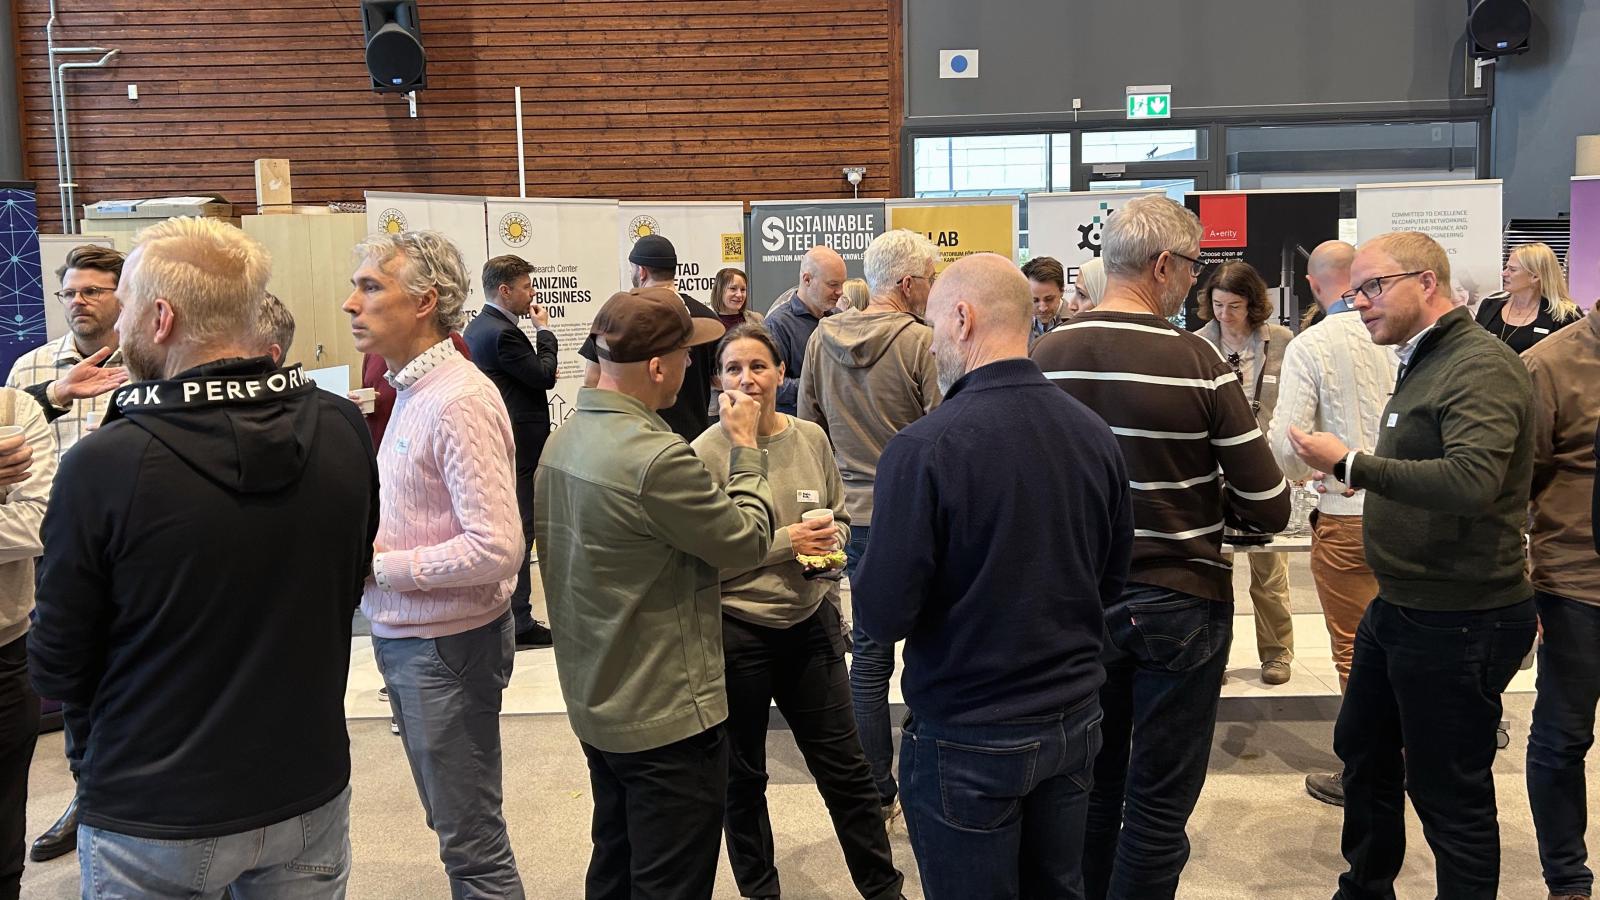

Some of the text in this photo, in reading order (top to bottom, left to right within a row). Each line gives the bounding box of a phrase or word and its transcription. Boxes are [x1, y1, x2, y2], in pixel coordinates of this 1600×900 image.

[1433, 209, 1467, 217] EXCELLENCE
[824, 232, 874, 250] REGION
[762, 254, 793, 262] INNOVATION
[842, 252, 864, 261] KNOWLE
[533, 264, 578, 273] search Center
[676, 263, 699, 276] TAD
[532, 276, 577, 290] ANIZING
[536, 290, 591, 304] BUSINESS
[116, 366, 310, 407] EAK PERFORM
